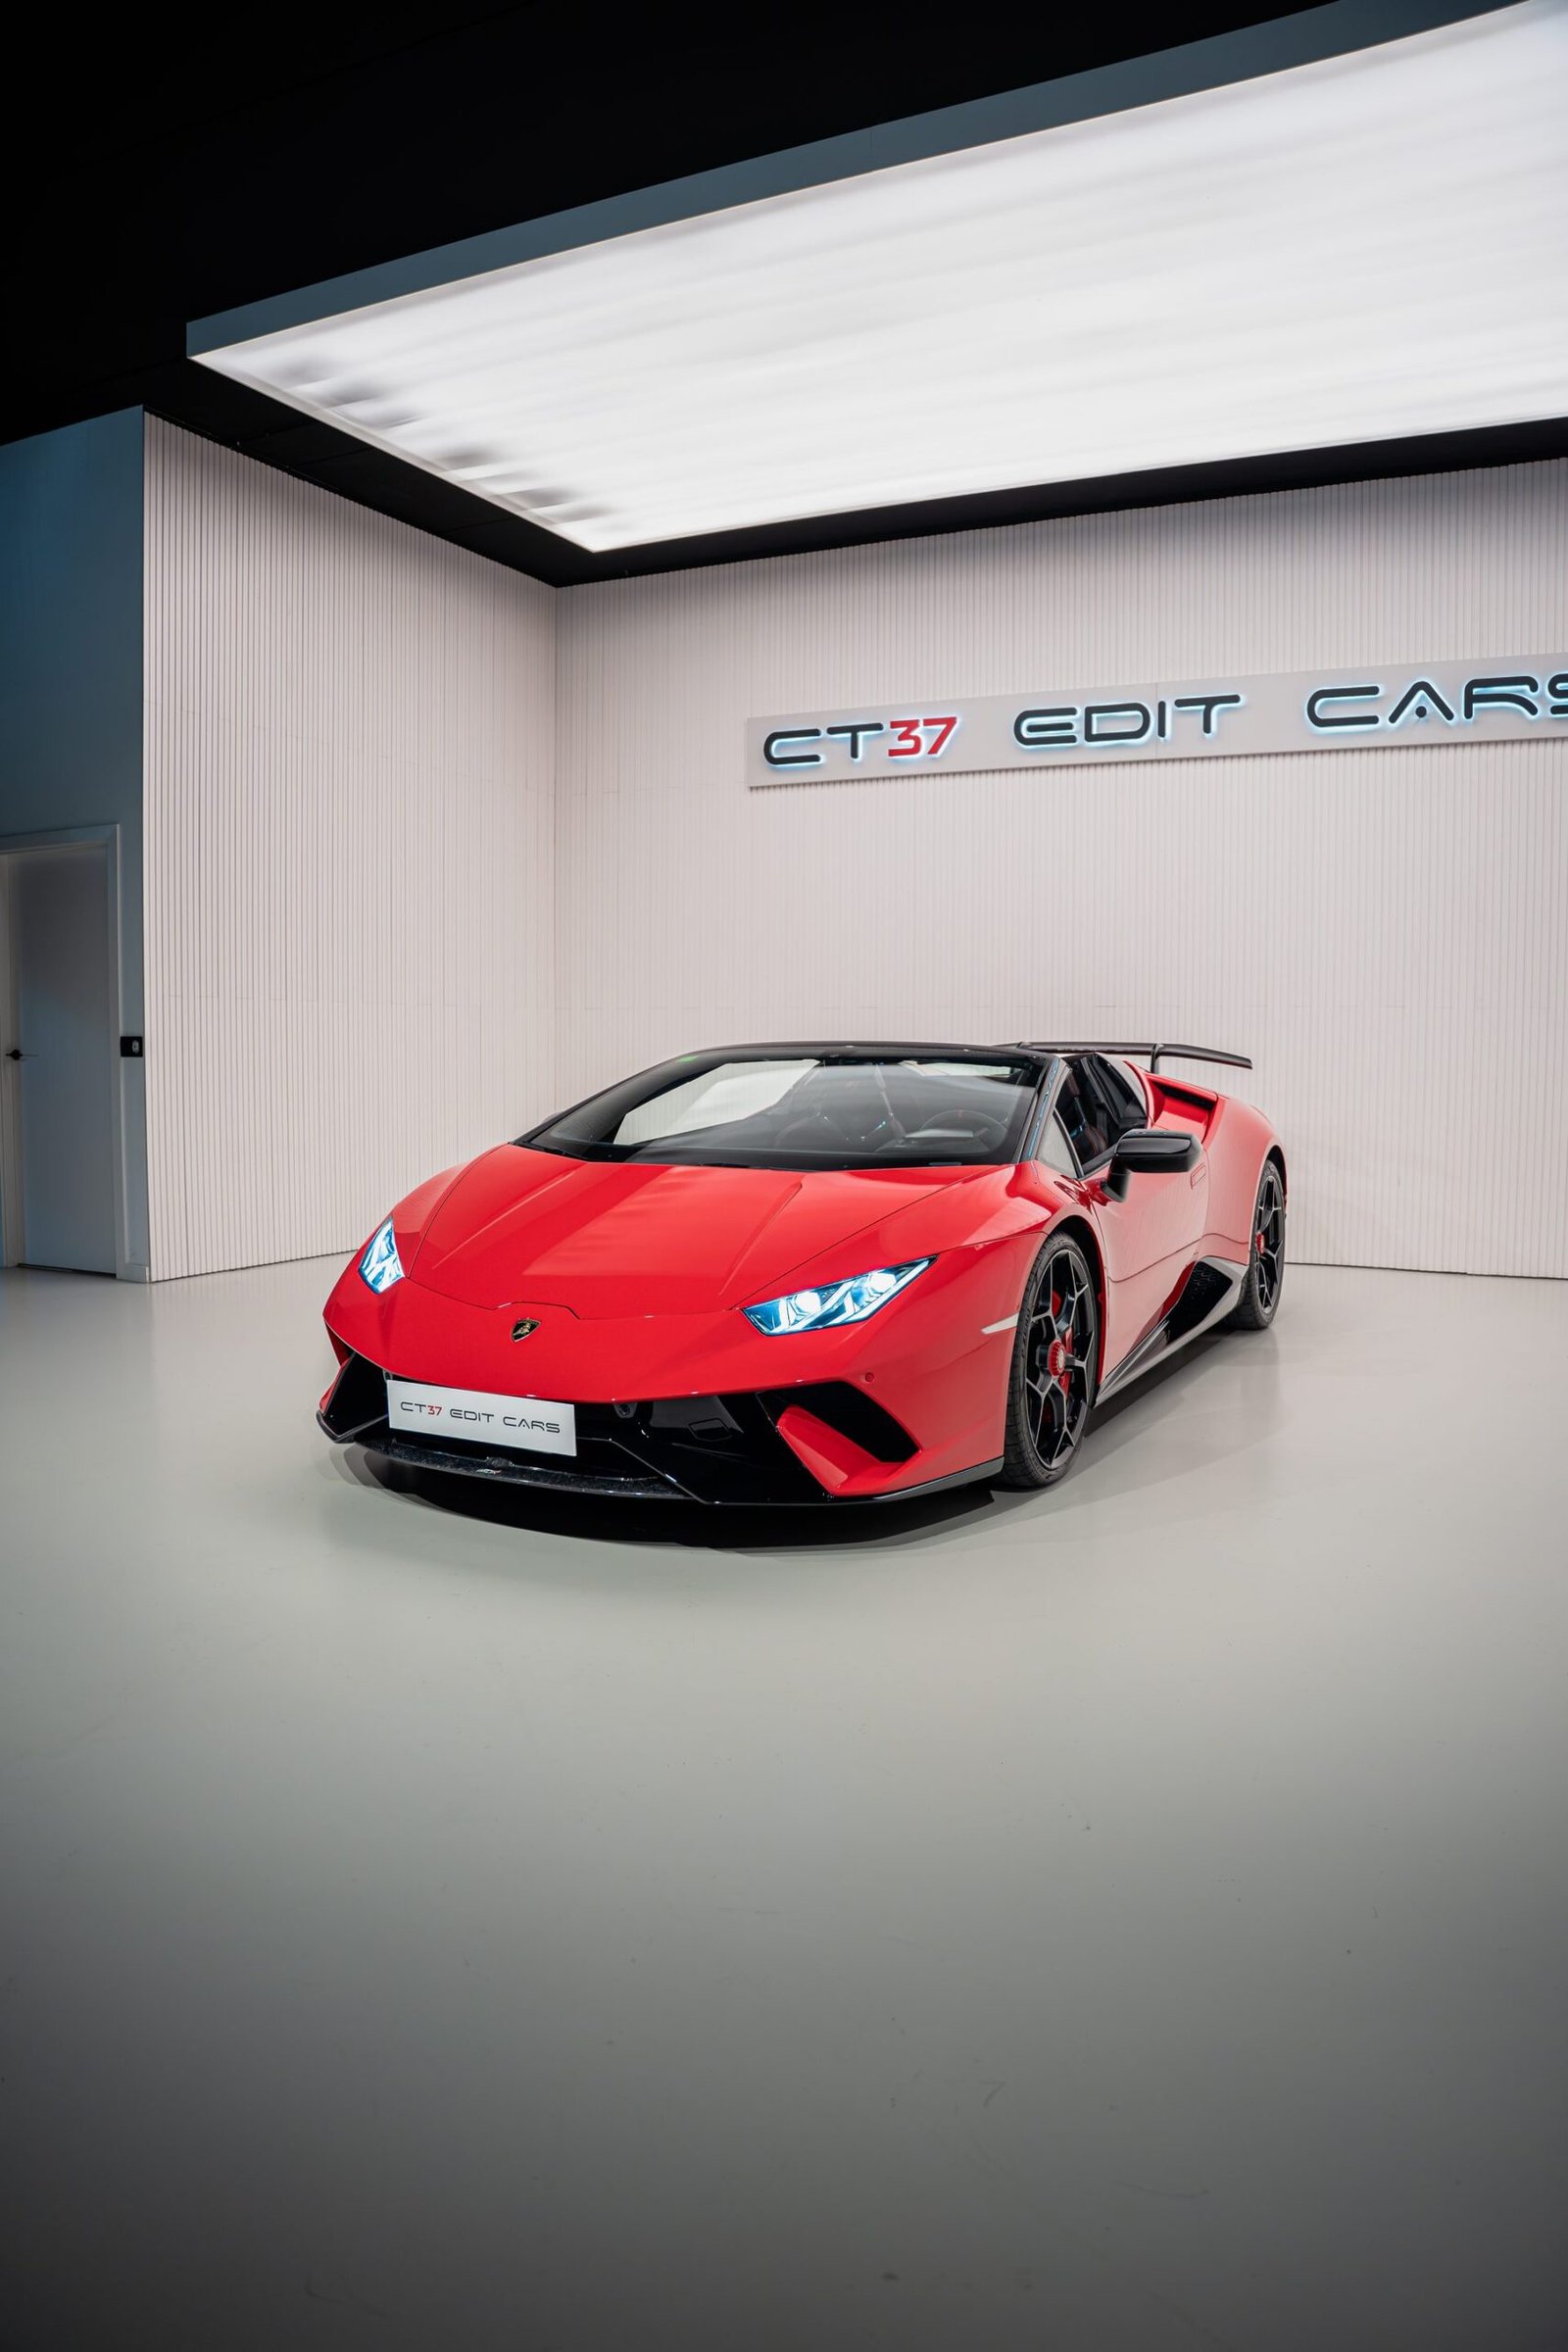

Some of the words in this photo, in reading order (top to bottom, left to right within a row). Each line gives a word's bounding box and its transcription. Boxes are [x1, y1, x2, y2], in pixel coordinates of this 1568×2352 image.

[762, 716, 956, 765] CT37
[1013, 694, 1241, 746] EDIT
[1306, 672, 1568, 729] CAR
[400, 1401, 442, 1416] CT37
[449, 1408, 495, 1424] EDIT
[502, 1415, 561, 1434] CARS
